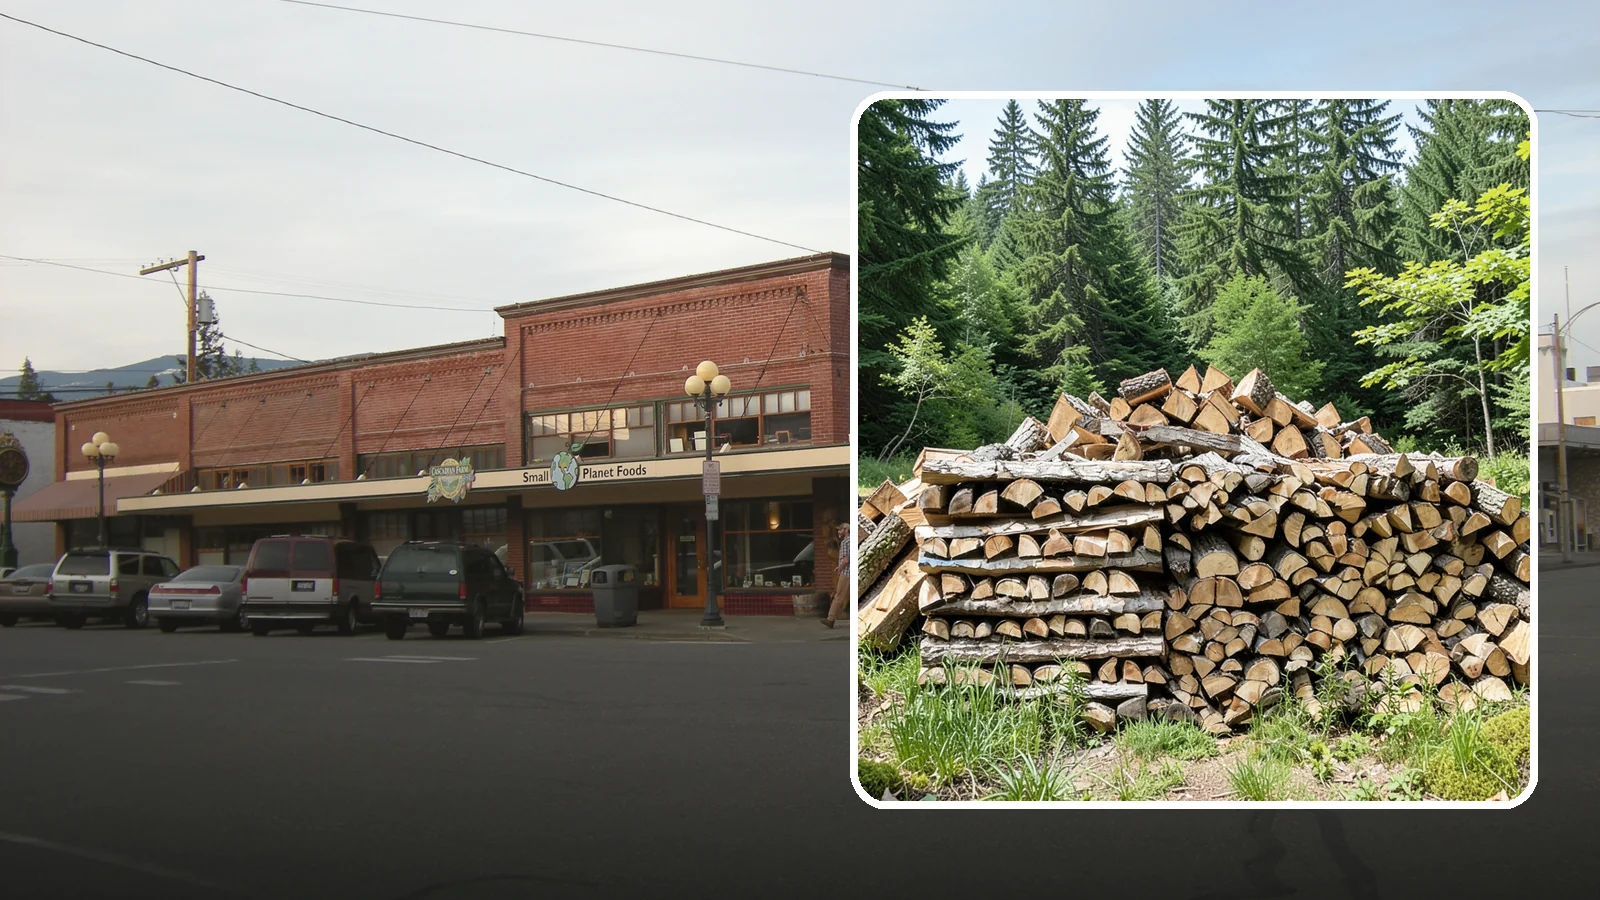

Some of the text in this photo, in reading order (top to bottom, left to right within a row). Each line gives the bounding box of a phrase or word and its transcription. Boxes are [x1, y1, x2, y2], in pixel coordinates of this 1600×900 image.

[431, 465, 469, 476] CASCADIAN FARM
[523, 464, 647, 483] Small Planet Foods
